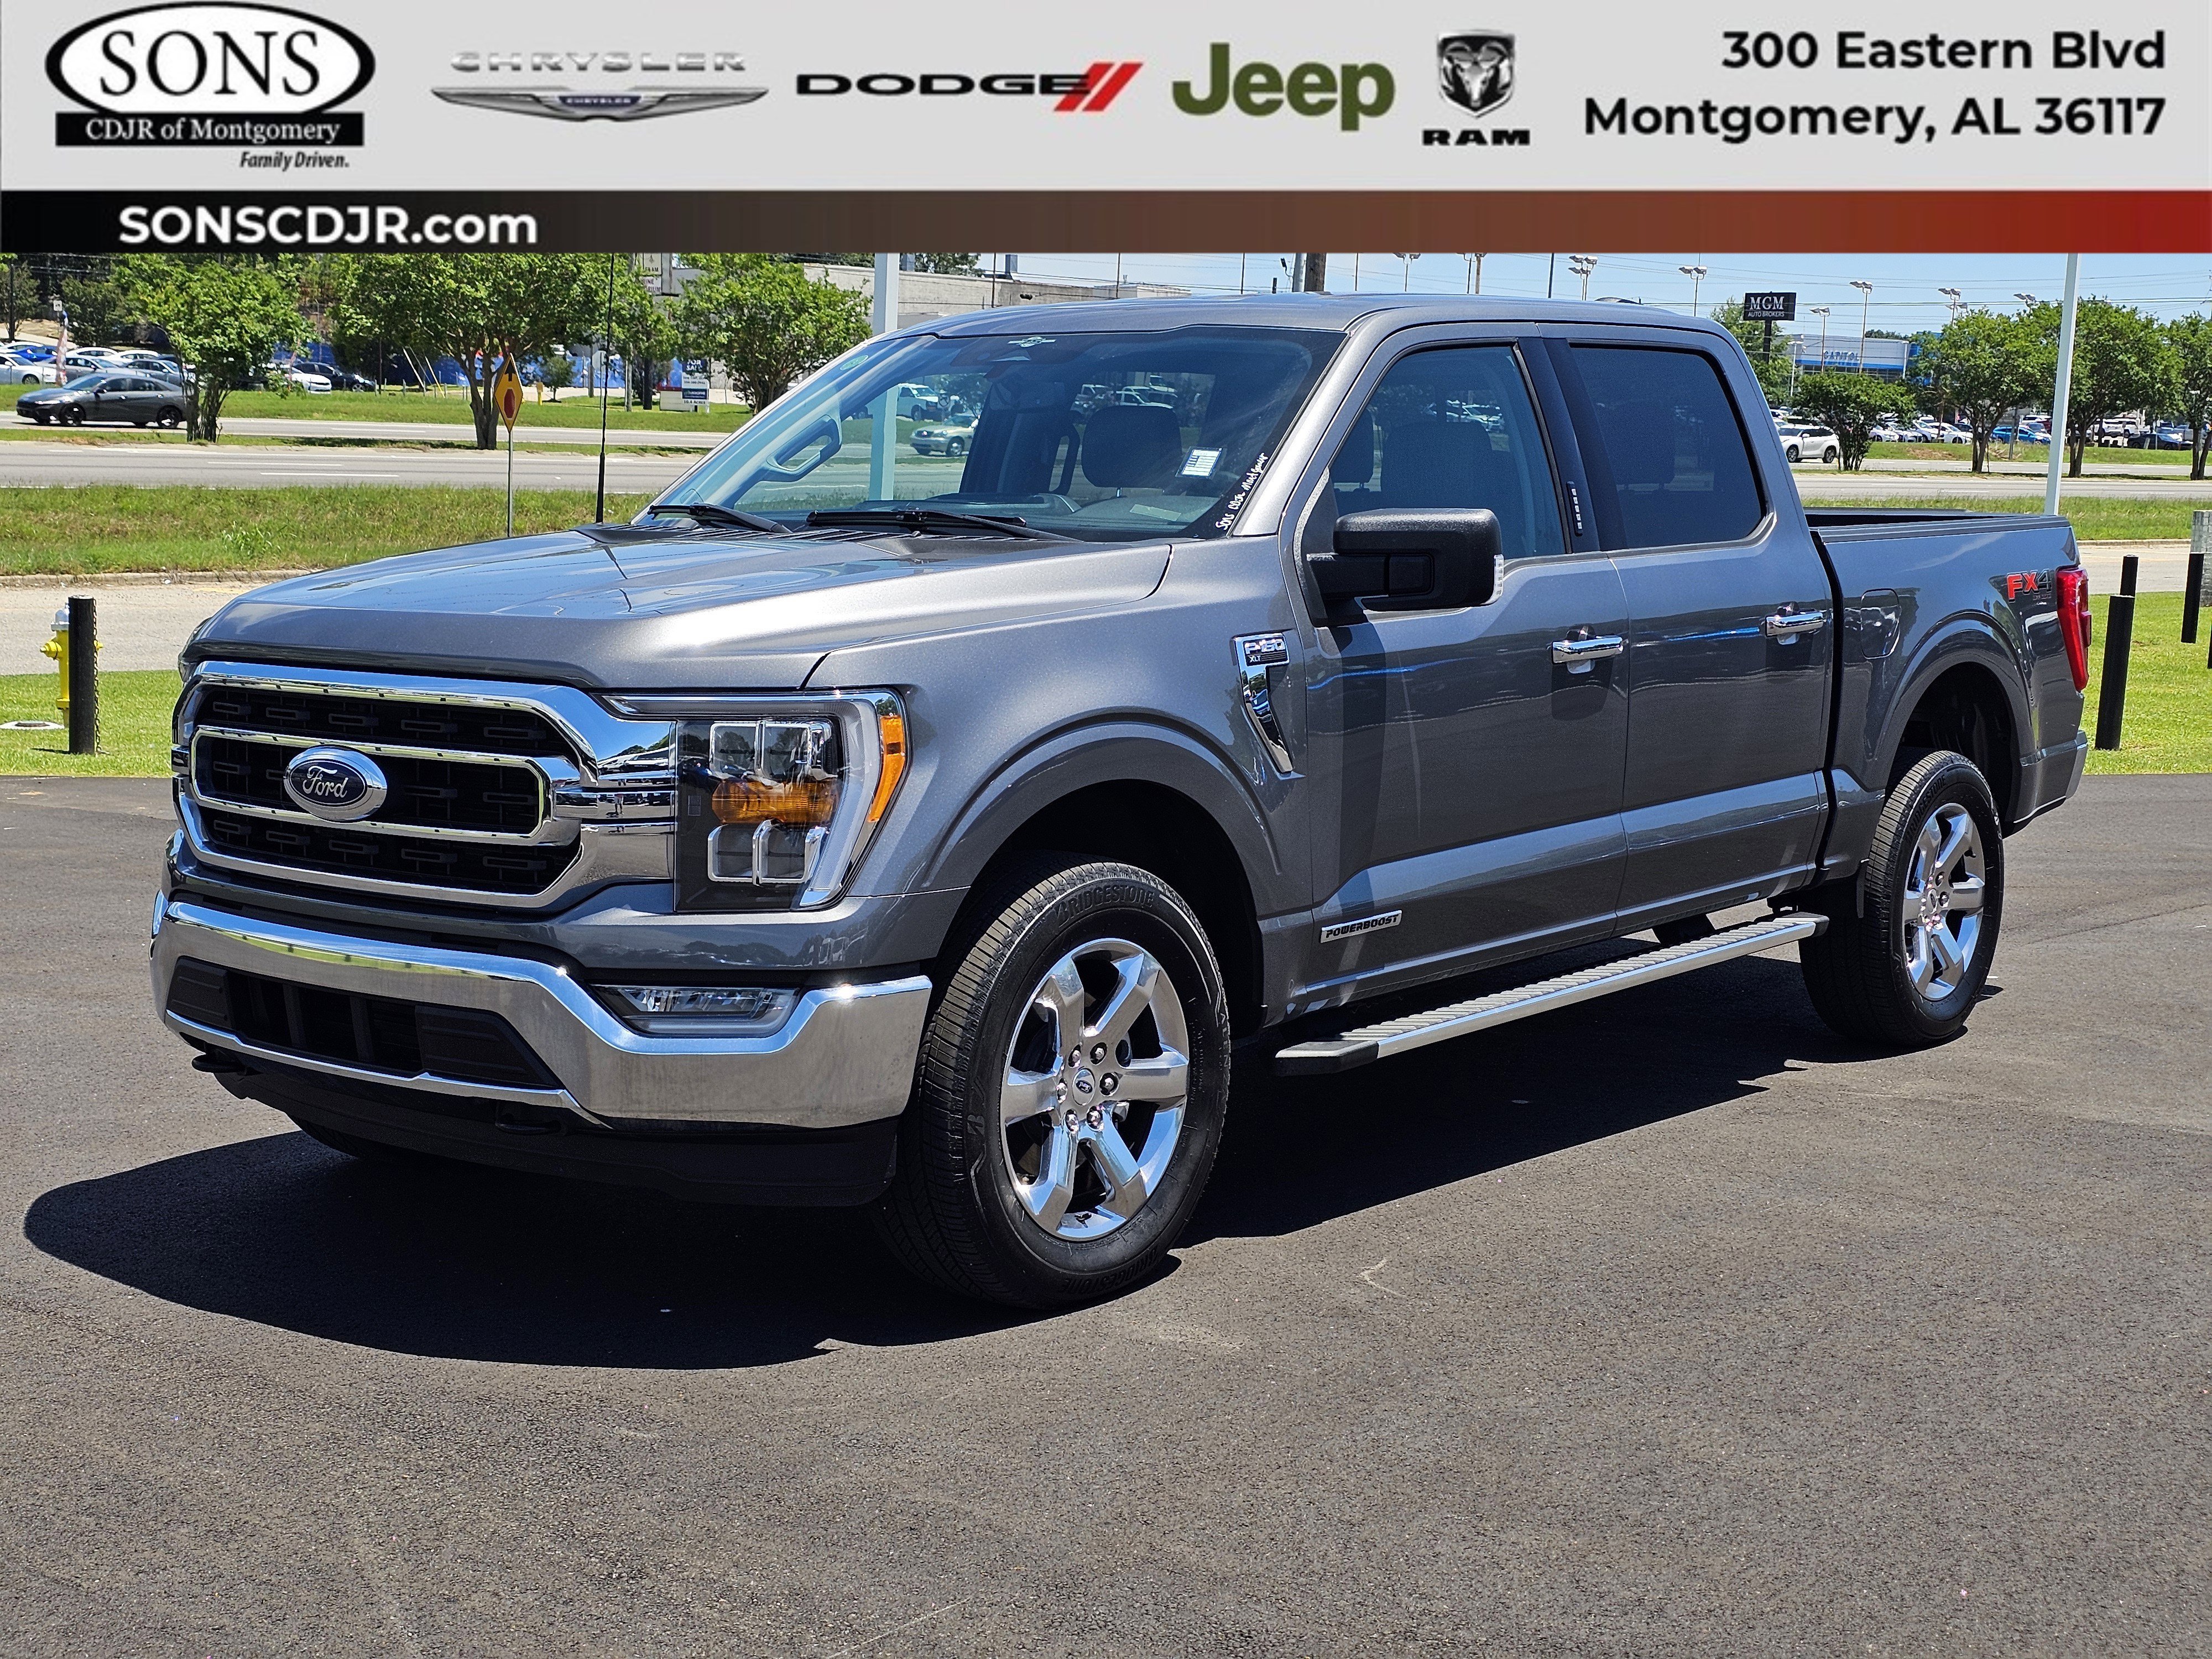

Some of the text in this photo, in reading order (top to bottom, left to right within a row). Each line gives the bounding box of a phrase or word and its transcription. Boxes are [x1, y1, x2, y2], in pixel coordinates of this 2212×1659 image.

[1749, 296, 1785, 310] MGM
[1824, 351, 1859, 361] CAPITOL
[2007, 568, 2052, 603] FX4
[1248, 655, 1261, 663] XLT
[302, 765, 349, 798] Ford
[1053, 884, 1155, 928] BRIDGESTONE
[1326, 914, 1400, 939] POWERBOOST
